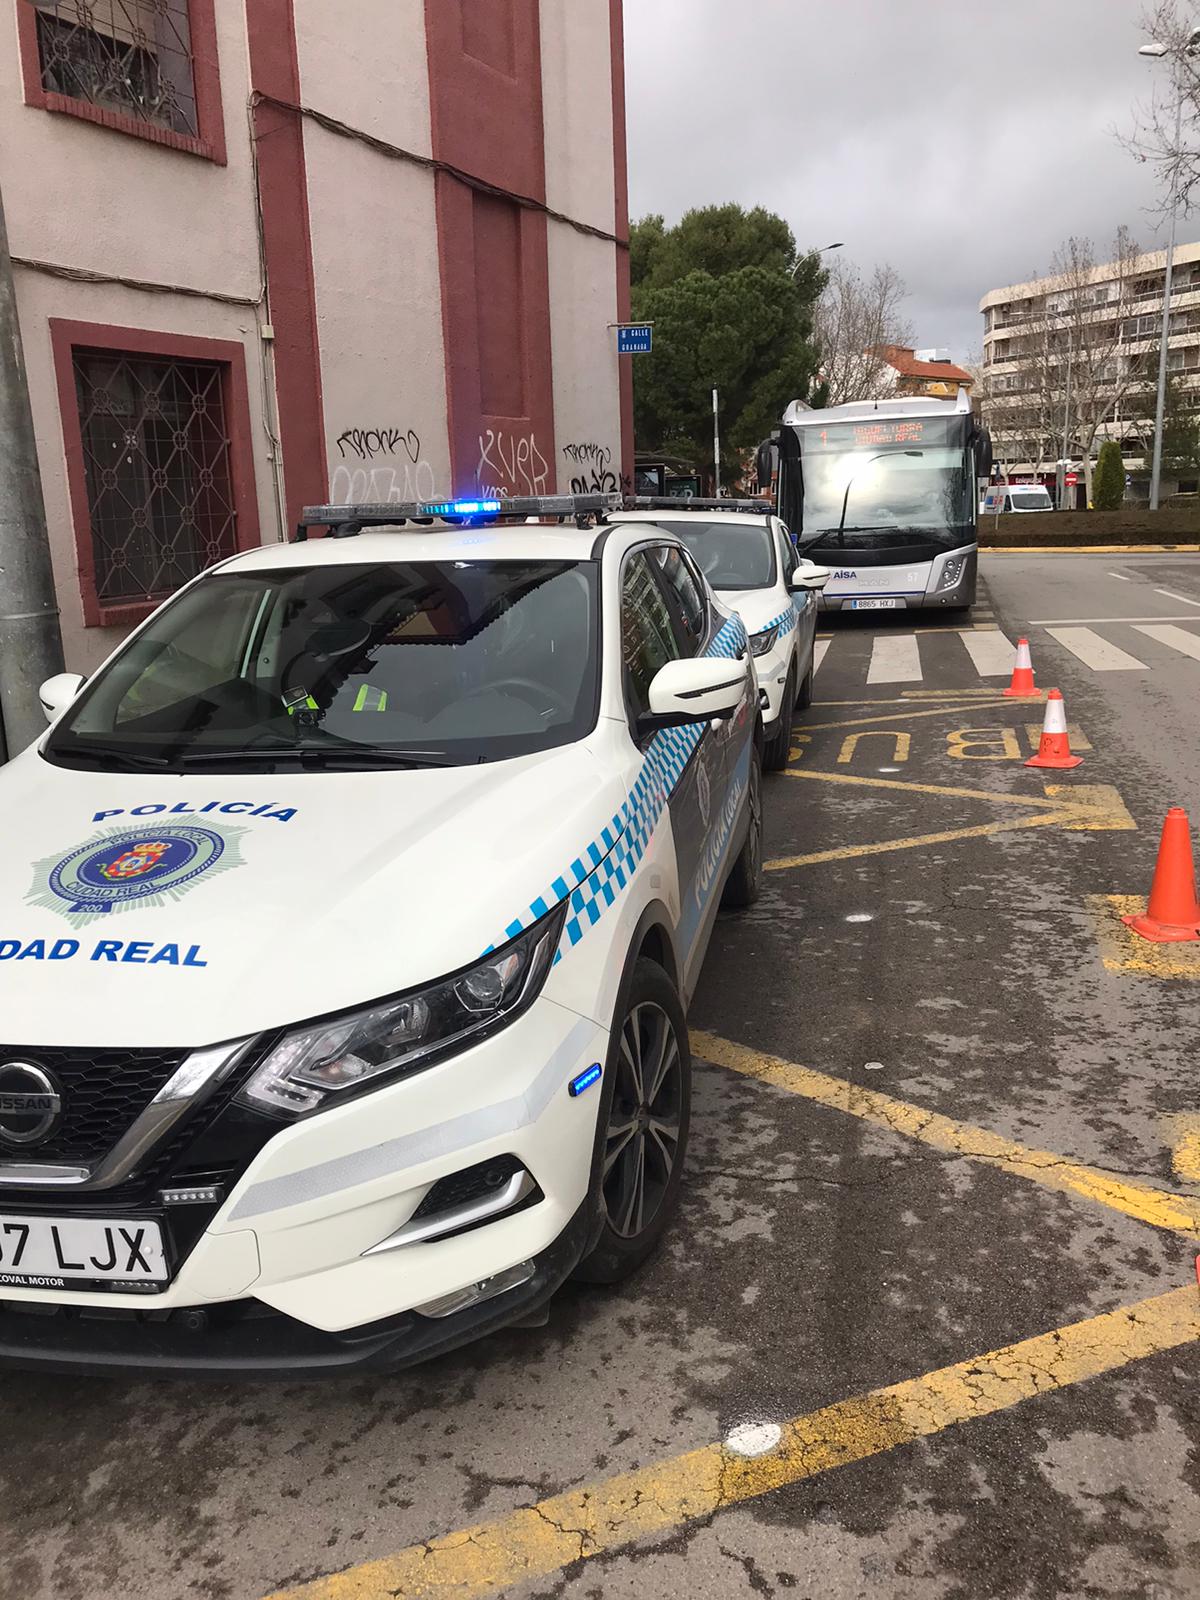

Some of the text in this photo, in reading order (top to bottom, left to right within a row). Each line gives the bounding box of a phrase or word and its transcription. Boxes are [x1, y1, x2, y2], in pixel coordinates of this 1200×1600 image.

[820, 429, 828, 448] 1
[895, 432, 922, 442] REAL
[879, 599, 894, 607] HXJ
[92, 800, 299, 823] POLICÍA
[172, 830, 210, 846] LOCAL
[66, 880, 160, 898] CIUDAD REAL
[78, 903, 104, 913] 200
[90, 940, 208, 968] REAL
[0, 1223, 153, 1274] 7 LJX
[28, 1276, 65, 1287] MOTOR
